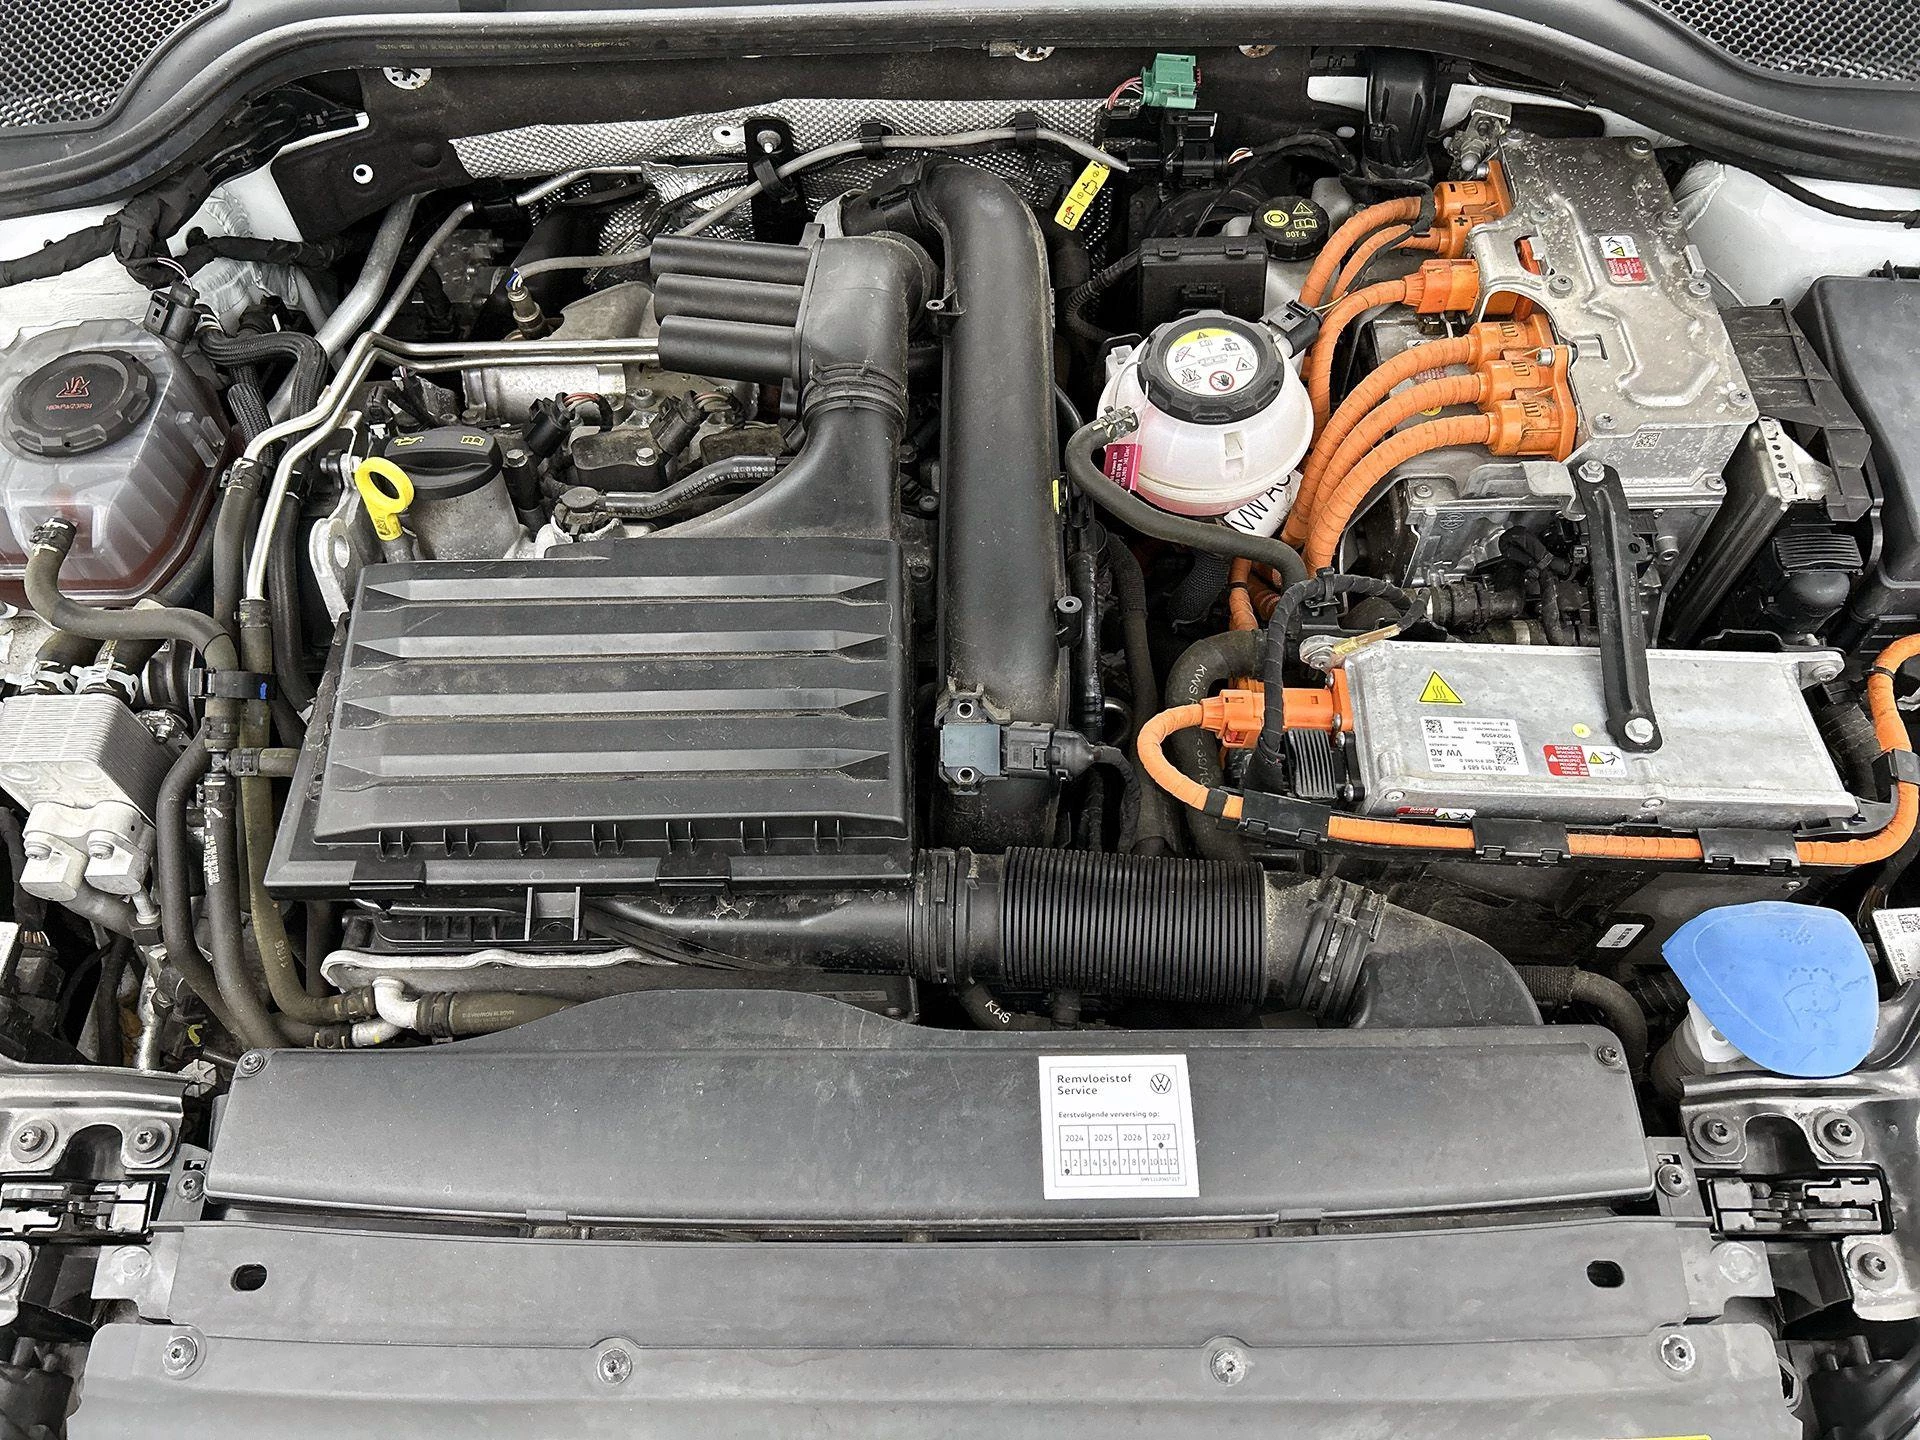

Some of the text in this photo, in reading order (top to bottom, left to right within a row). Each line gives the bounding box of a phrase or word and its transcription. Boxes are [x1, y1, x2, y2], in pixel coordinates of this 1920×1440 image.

[1231, 499, 1269, 531] VW
[1188, 664, 1208, 695] KWS
[1430, 748, 1462, 757] VW AG
[984, 1000, 1012, 1024] KWS
[1056, 1074, 1132, 1084] Remvloeistof
[1057, 1086, 1098, 1096] Service
[1058, 1111, 1109, 1119] Eerstvolgende
[1065, 1134, 1084, 1142] 2024
